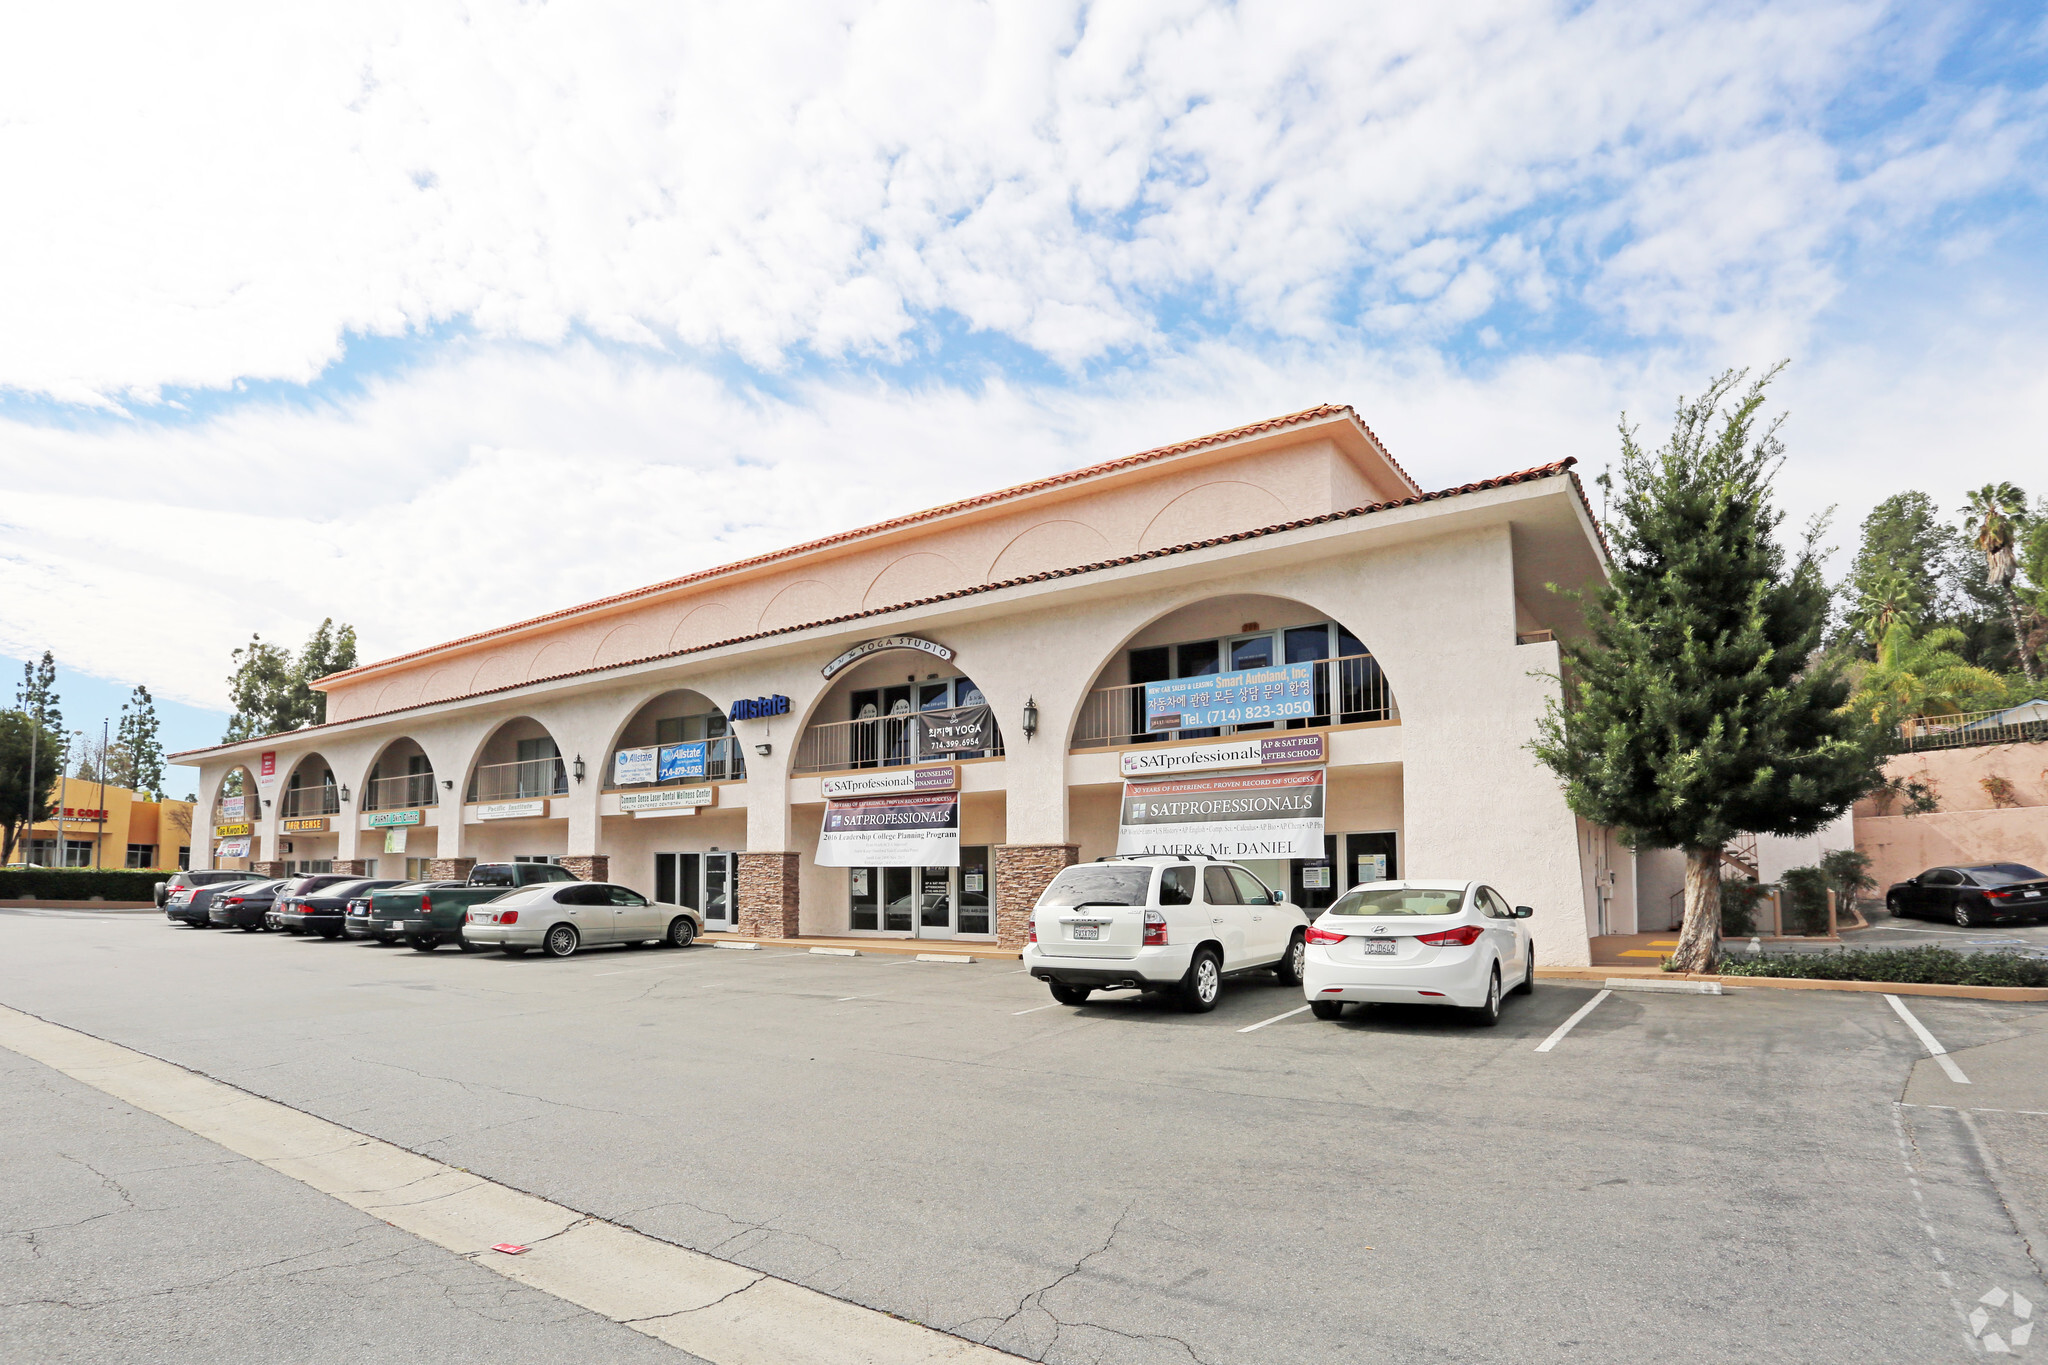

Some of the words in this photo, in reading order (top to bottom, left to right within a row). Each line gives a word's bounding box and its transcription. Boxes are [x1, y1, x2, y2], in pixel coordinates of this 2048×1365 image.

[860, 639, 892, 652] YOGA
[900, 638, 946, 656] STUDIO
[1216, 674, 1243, 688] Smart
[1246, 670, 1289, 684] Autoland,
[1292, 667, 1309, 679] Inc.
[1193, 680, 1213, 689] LEASING
[1148, 695, 1186, 712] 자동차에
[1190, 692, 1210, 708] 관한
[1214, 690, 1234, 704] 모든
[1238, 686, 1259, 702] 상담
[1263, 682, 1284, 699] 문의
[1289, 680, 1310, 697] 환영
[728, 694, 788, 721] Allstate
[1184, 713, 1202, 725] Tel.
[1208, 708, 1241, 724] (714)
[1246, 700, 1311, 718] 823-3050
[955, 724, 981, 735] YOGA
[931, 738, 979, 749] 714.399.6954
[1298, 738, 1318, 746] PREP
[629, 753, 652, 763] Allstate
[673, 748, 701, 759] Allstate
[1140, 746, 1261, 768] SATprofessionals
[1262, 752, 1286, 760] AFTER
[1287, 749, 1320, 758] SCHOOL
[916, 770, 952, 778] COUNSELING
[834, 776, 914, 792] SATprofessionals
[638, 794, 649, 802] Sense
[650, 793, 661, 802] Laser
[662, 792, 675, 801] Dental
[677, 790, 695, 799] Wellness
[696, 789, 710, 798] Center
[1150, 795, 1312, 817] SATPROFESSIONALS
[403, 812, 418, 821] Clinic
[844, 810, 950, 826] SATPROFESSIONALS
[217, 826, 225, 835] Tae
[226, 826, 240, 834] Kwon
[241, 824, 248, 834] Do
[302, 820, 321, 829] SENSE
[839, 833, 870, 841] Leadership
[873, 832, 896, 840] College
[897, 832, 924, 840] Planning
[926, 831, 957, 839] Program
[1210, 843, 1231, 854] Mr.
[1237, 841, 1296, 854] DANIEL
